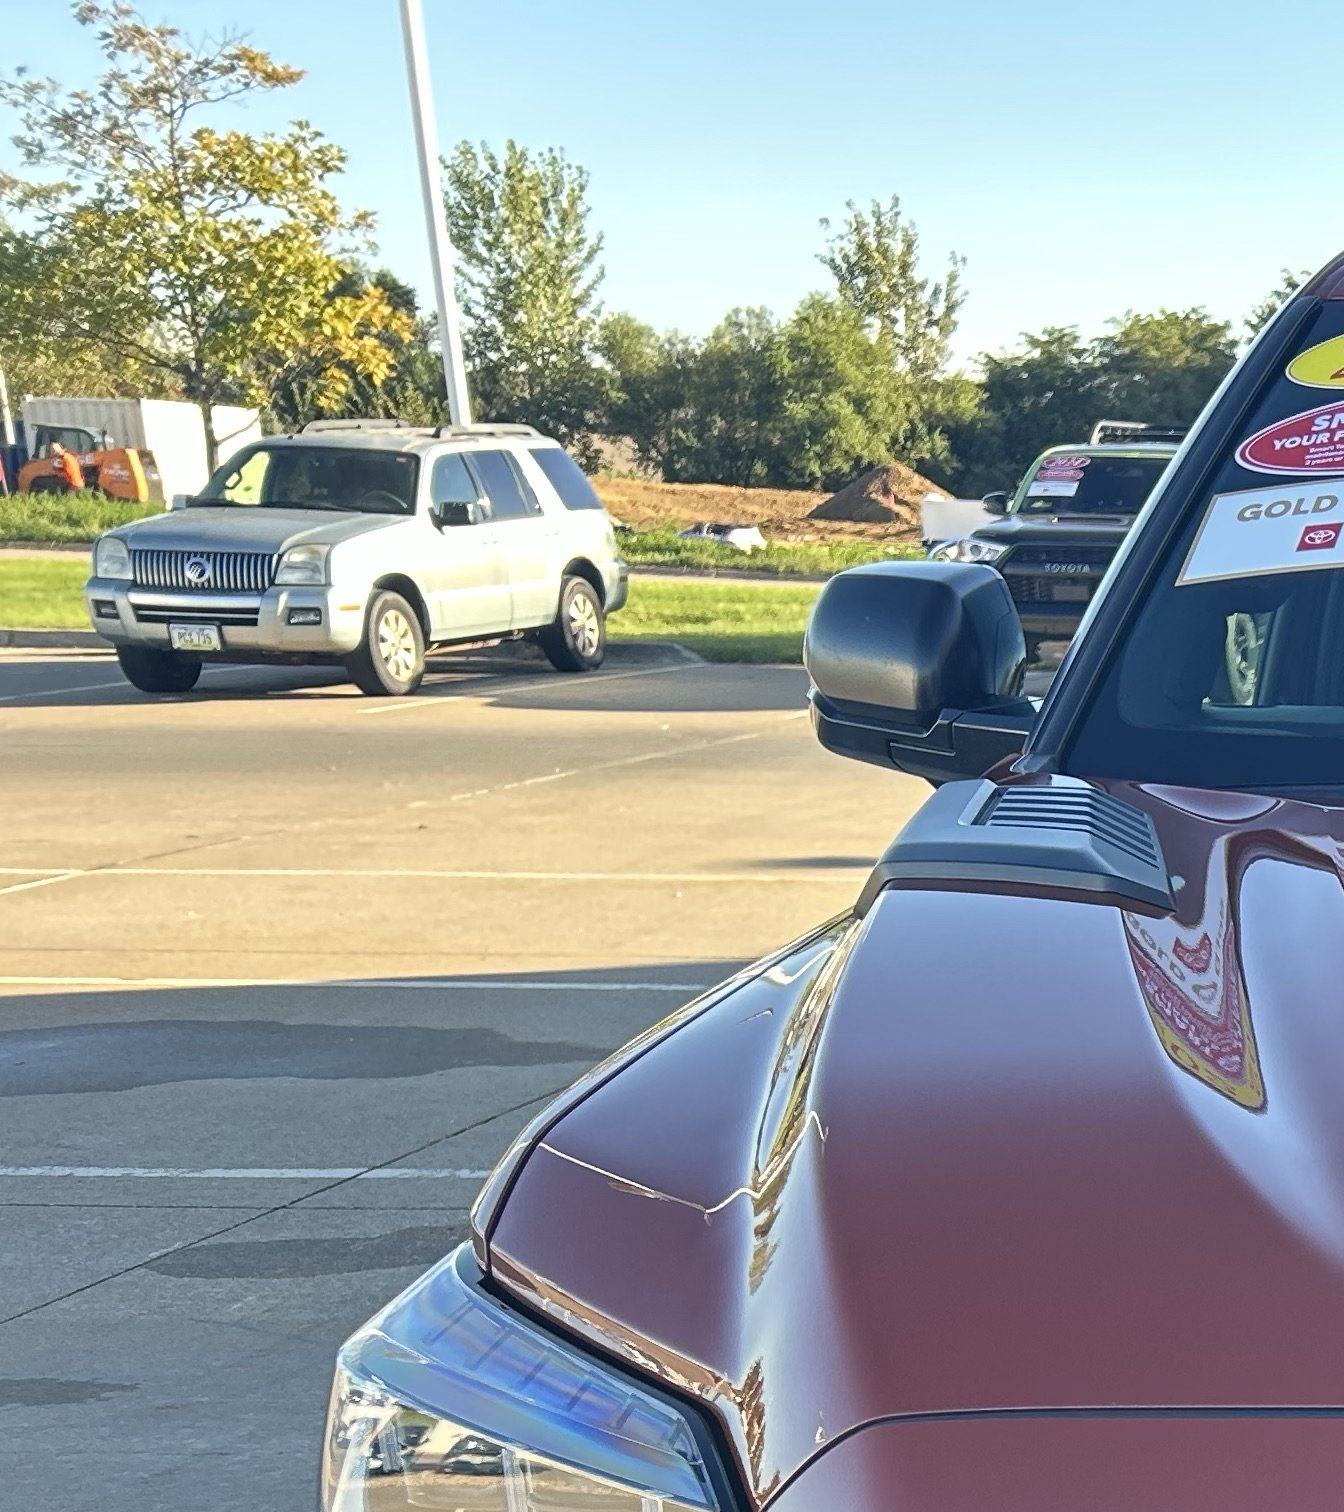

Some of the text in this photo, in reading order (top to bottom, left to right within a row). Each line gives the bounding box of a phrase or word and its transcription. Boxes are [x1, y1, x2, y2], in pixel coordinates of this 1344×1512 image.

[1273, 432, 1331, 450] YOUR
[1236, 494, 1339, 522] GOLD
[1044, 563, 1090, 573] TOYOTA
